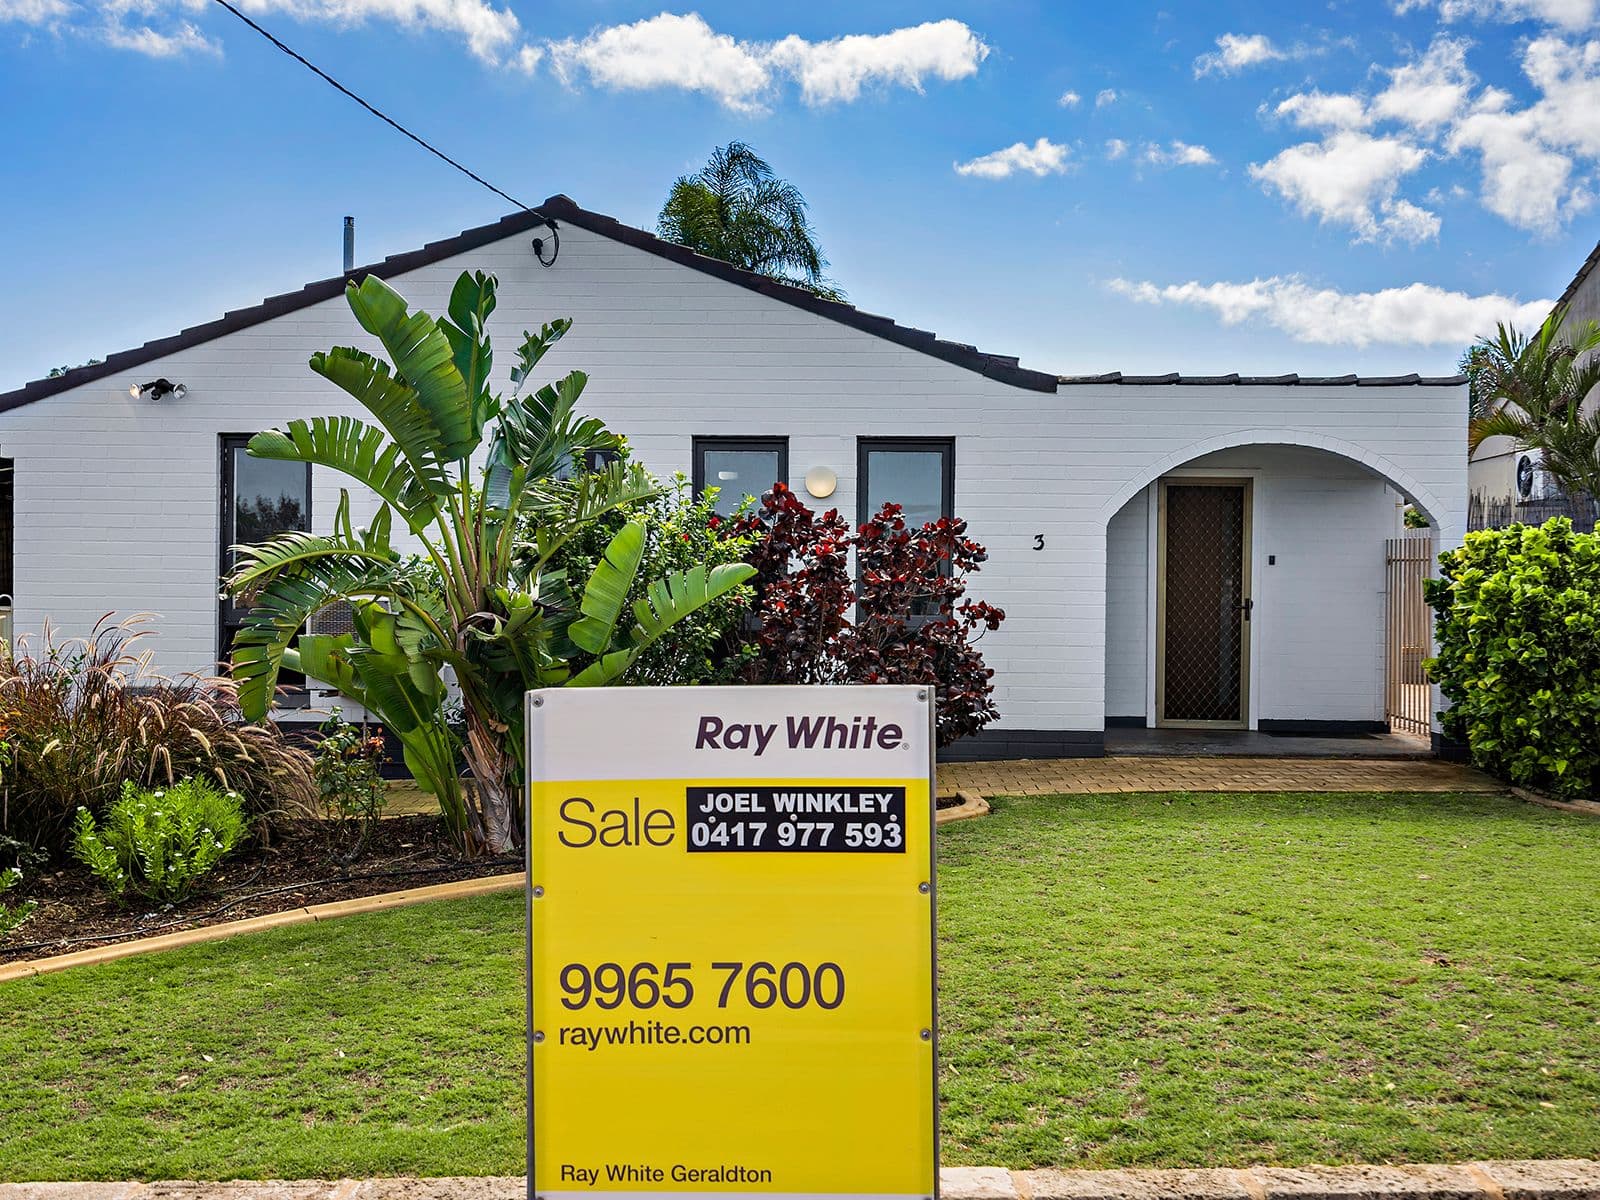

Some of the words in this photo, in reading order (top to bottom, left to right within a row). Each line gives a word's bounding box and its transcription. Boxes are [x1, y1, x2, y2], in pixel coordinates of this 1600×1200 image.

[1032, 533, 1044, 551] 3
[695, 716, 778, 757] Ray
[786, 716, 903, 750] White
[699, 792, 767, 814] JOEL
[772, 792, 893, 814] WINKLEY
[558, 797, 676, 849] Sale
[691, 822, 772, 847] 0417
[777, 822, 835, 847] 977
[844, 822, 903, 847] 593
[559, 962, 695, 1010] 9965
[711, 962, 846, 1010] 7600
[559, 1020, 751, 1052] raywhite.com
[560, 1164, 600, 1187] Ray
[606, 1164, 665, 1183] White
[671, 1164, 772, 1183] Geraldton
